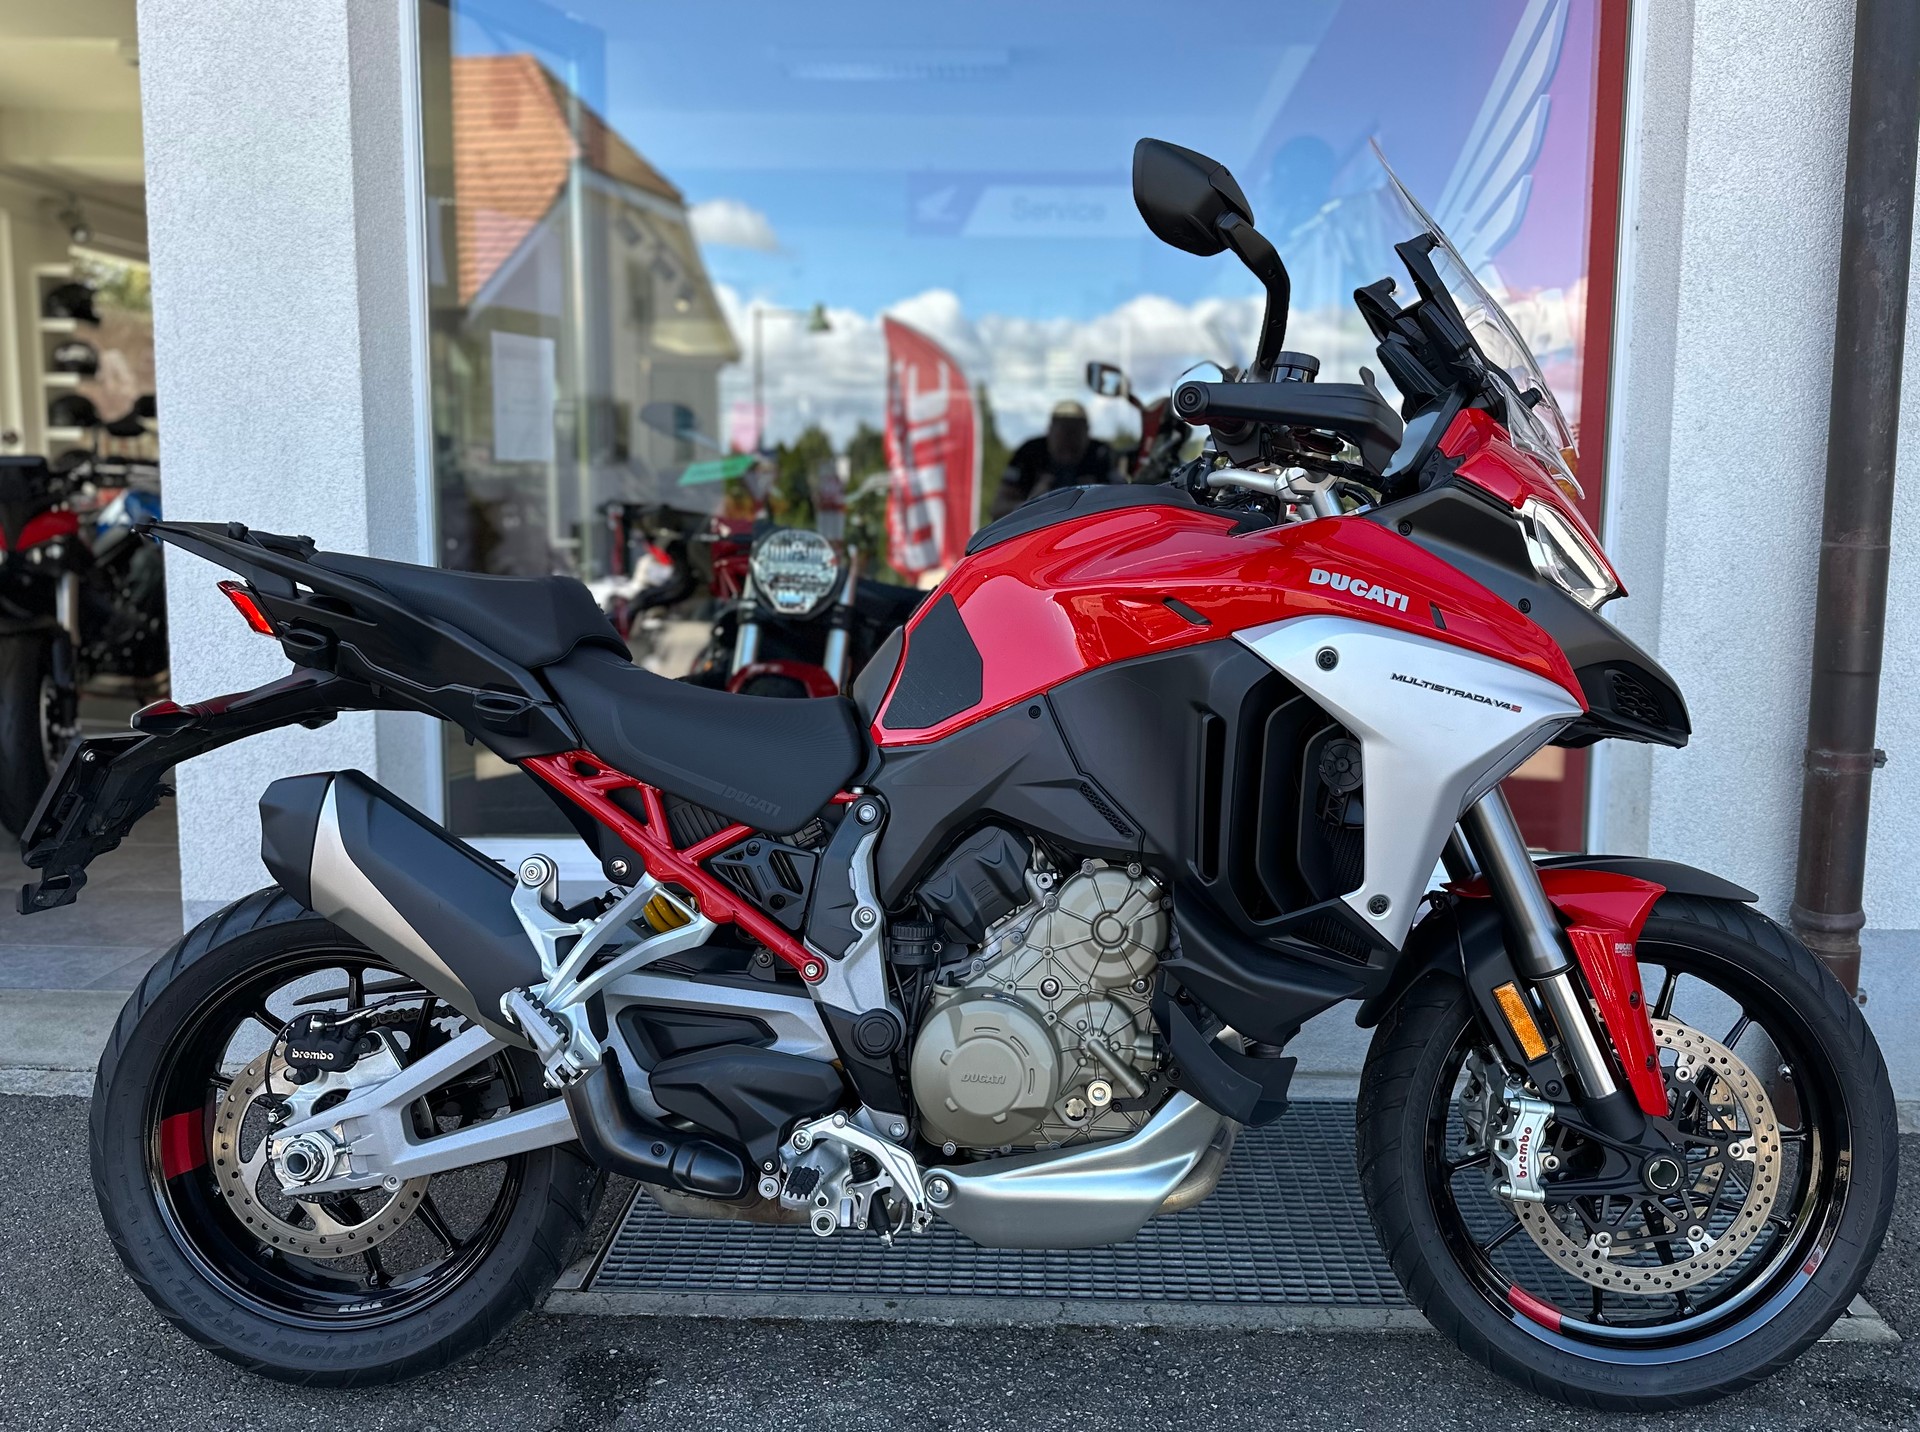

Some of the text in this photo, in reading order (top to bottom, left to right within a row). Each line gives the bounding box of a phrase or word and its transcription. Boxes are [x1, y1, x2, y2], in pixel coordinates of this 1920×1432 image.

[1010, 195, 1107, 222] Service
[1309, 568, 1409, 612] DUCATI
[721, 786, 781, 816] DUCATI
[292, 1048, 334, 1061] brembo
[961, 1073, 1006, 1085] DUCATI
[1516, 1126, 1532, 1179] brembo
[170, 1279, 263, 1347] TRAIL
[269, 1306, 454, 1363] SCORPION
